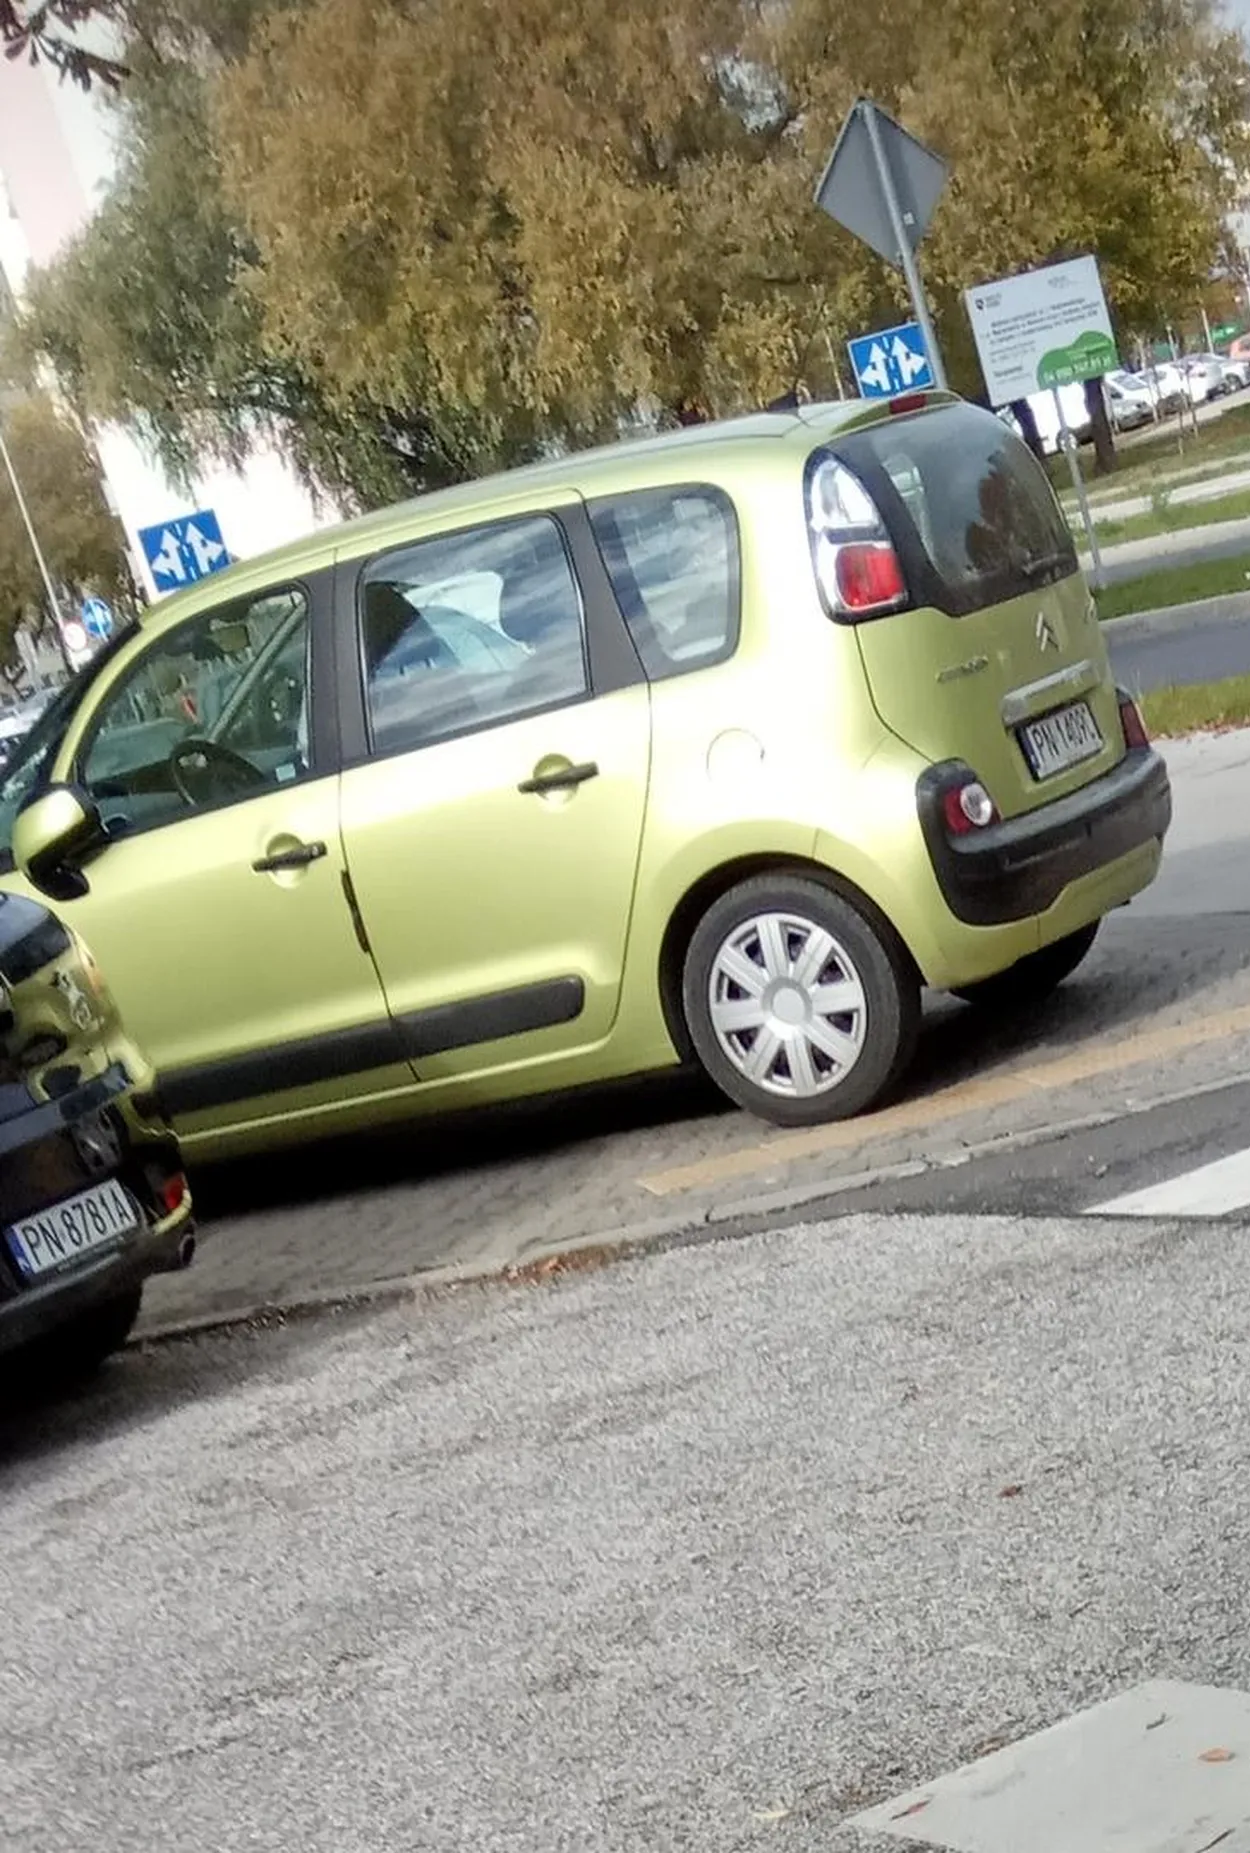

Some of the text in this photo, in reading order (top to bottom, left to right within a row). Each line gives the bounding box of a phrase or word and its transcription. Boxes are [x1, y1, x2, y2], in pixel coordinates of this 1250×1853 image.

[1031, 723, 1060, 765] PN
[21, 1187, 132, 1267] PN 8781A
